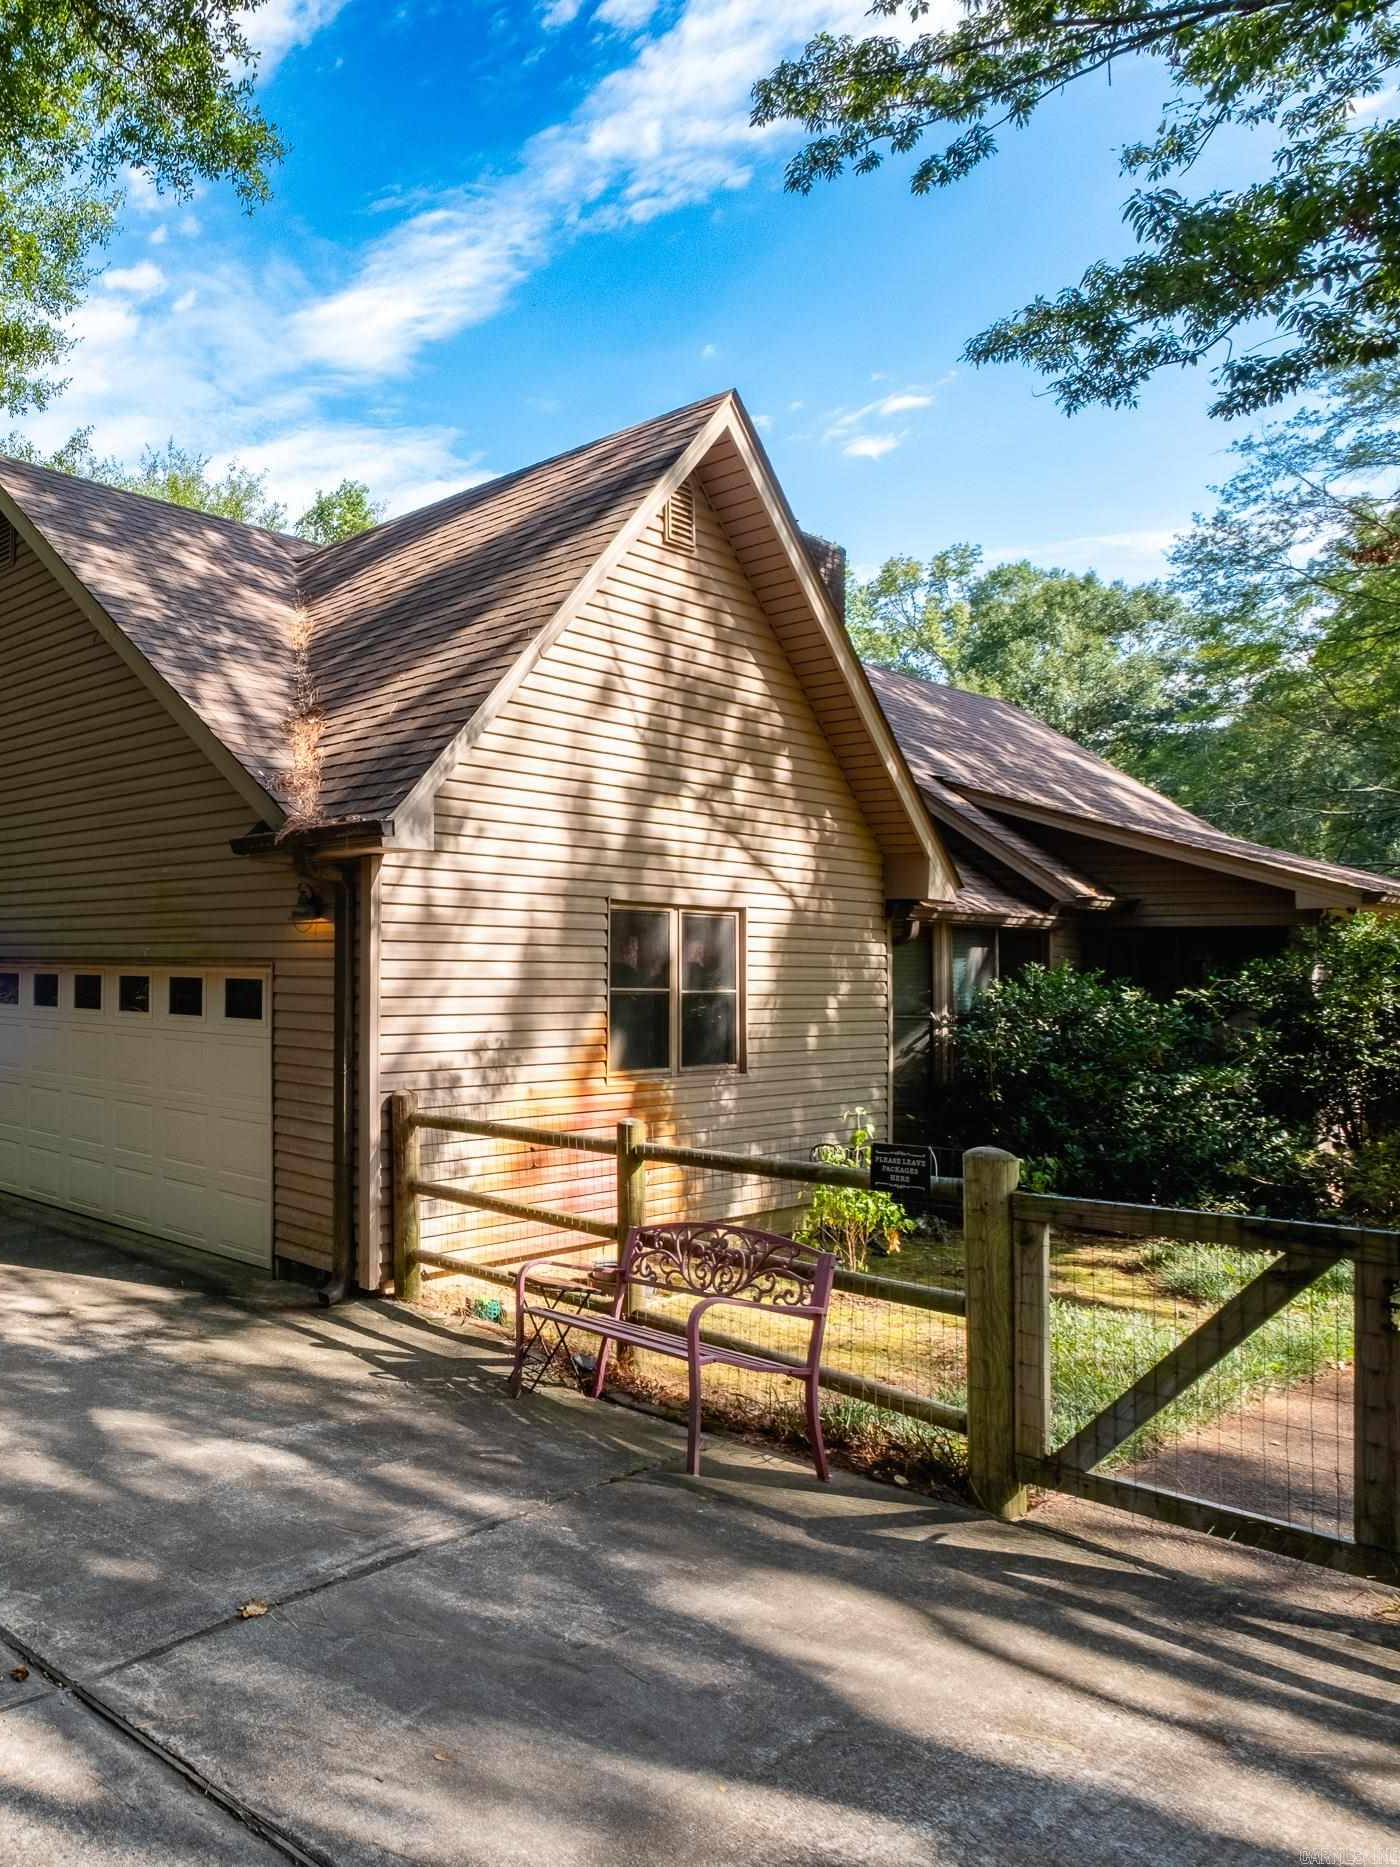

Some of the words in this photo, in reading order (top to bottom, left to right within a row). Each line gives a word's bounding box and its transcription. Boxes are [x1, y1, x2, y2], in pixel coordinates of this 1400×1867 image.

[874, 1156, 901, 1165] PLEASE
[902, 1158, 926, 1167] LEAVE
[881, 1165, 919, 1175] PACKAGES
[890, 1174, 910, 1183] HERE
